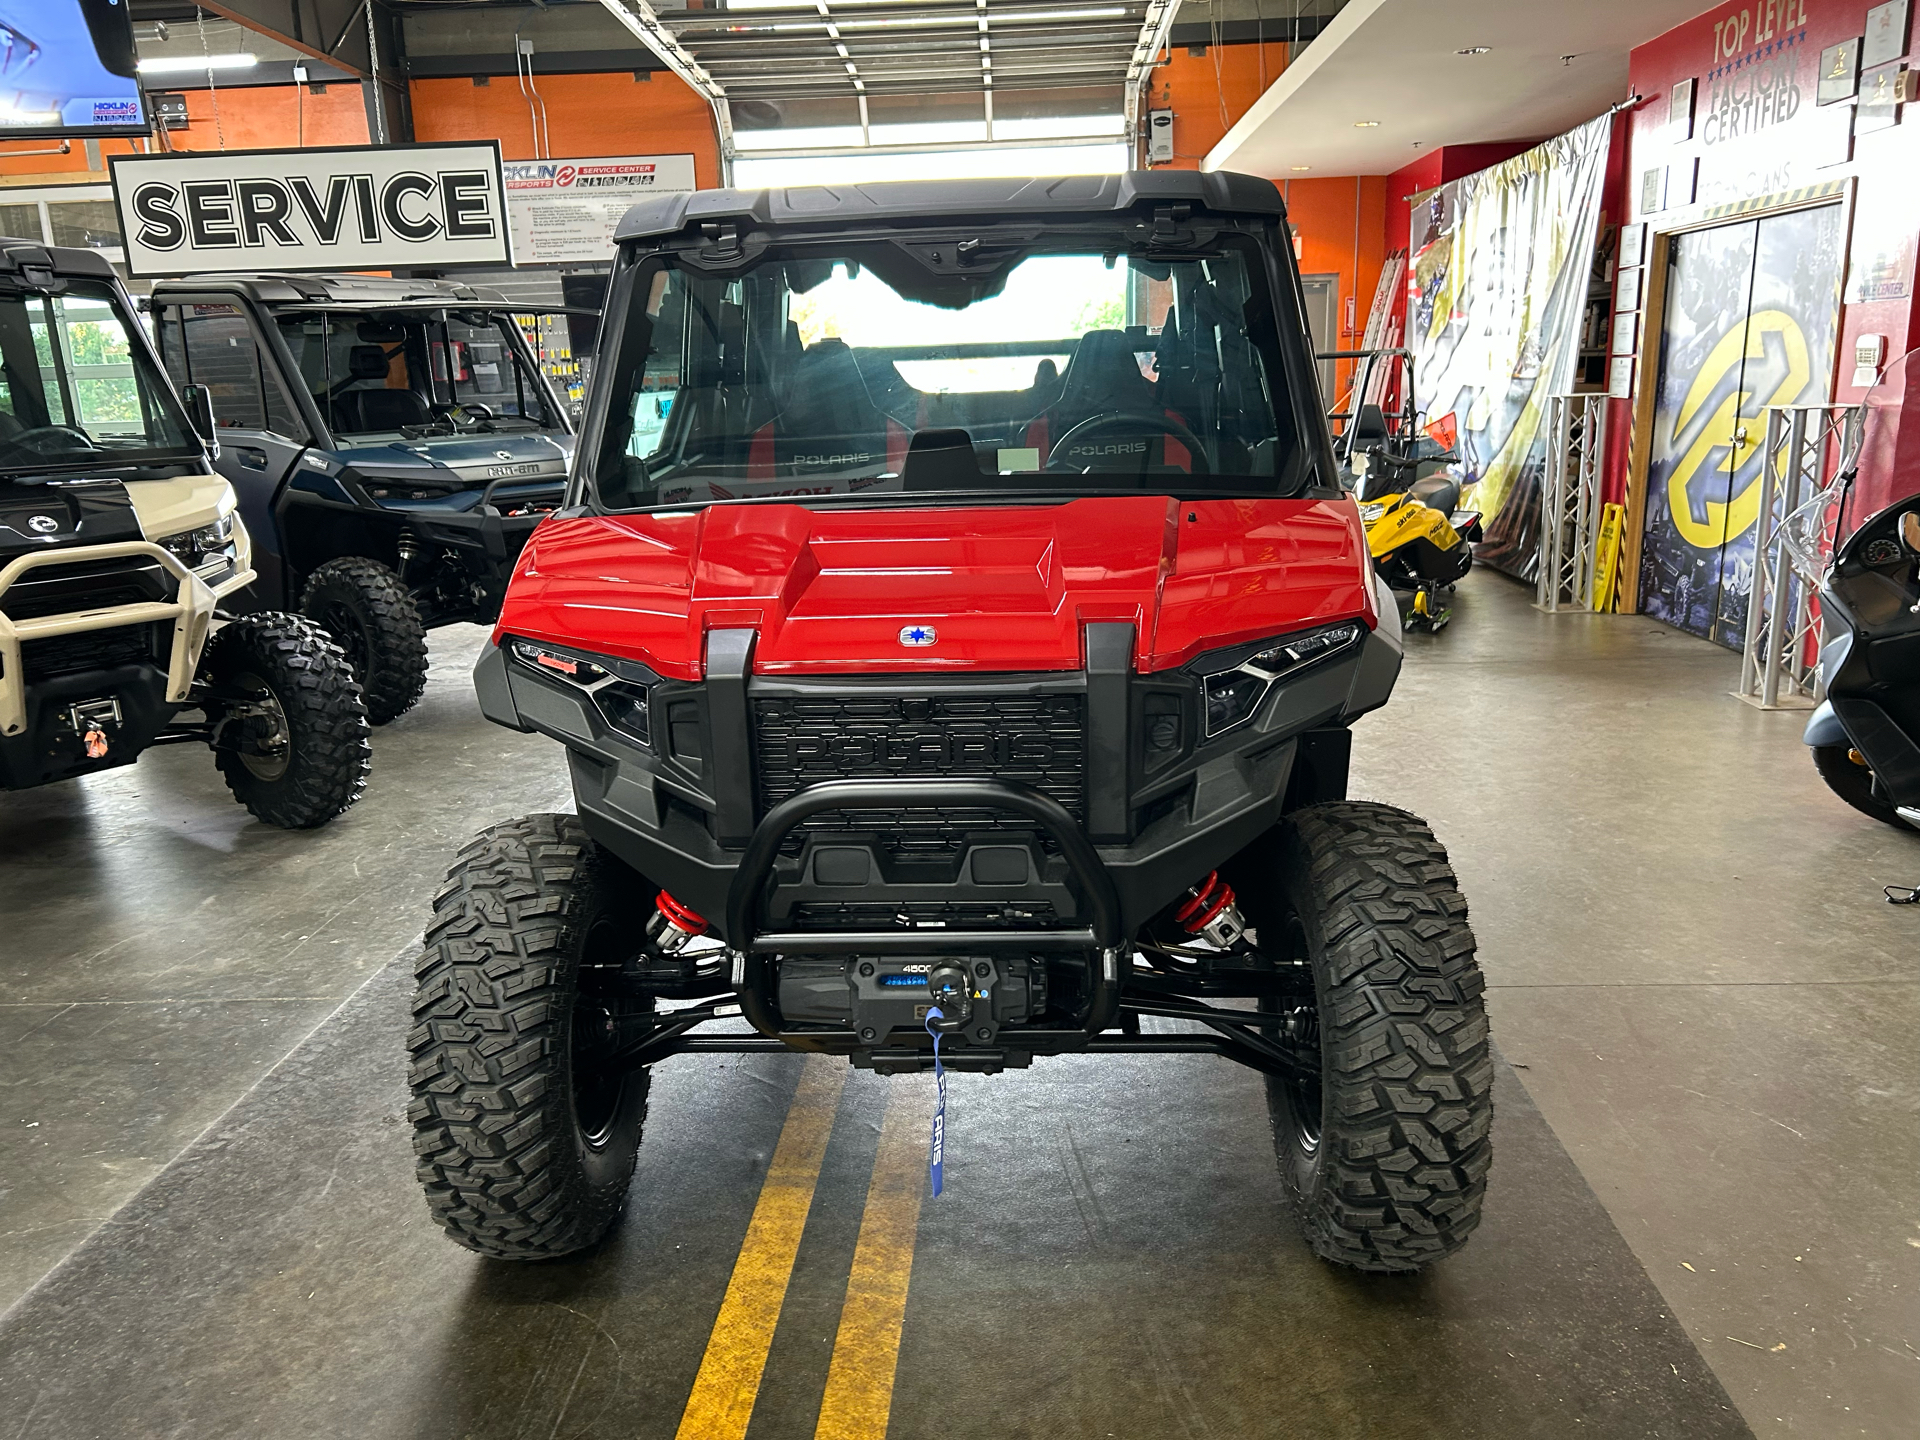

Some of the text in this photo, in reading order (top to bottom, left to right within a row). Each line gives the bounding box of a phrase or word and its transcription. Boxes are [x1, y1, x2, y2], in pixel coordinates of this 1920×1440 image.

[1713, 9, 1750, 64] TOP
[1754, 0, 1807, 45] LEVEL
[1710, 46, 1800, 114] FACTORY
[1703, 84, 1800, 146] CERTIFIED
[504, 164, 558, 180] CKLIN
[583, 164, 651, 174] SERVICE CENTER
[506, 180, 552, 189] RSPORTS
[132, 170, 496, 252] SERVICE
[793, 452, 870, 465] POLARIS
[1068, 442, 1147, 456] POLARIS
[785, 734, 1053, 767] POLARIS
